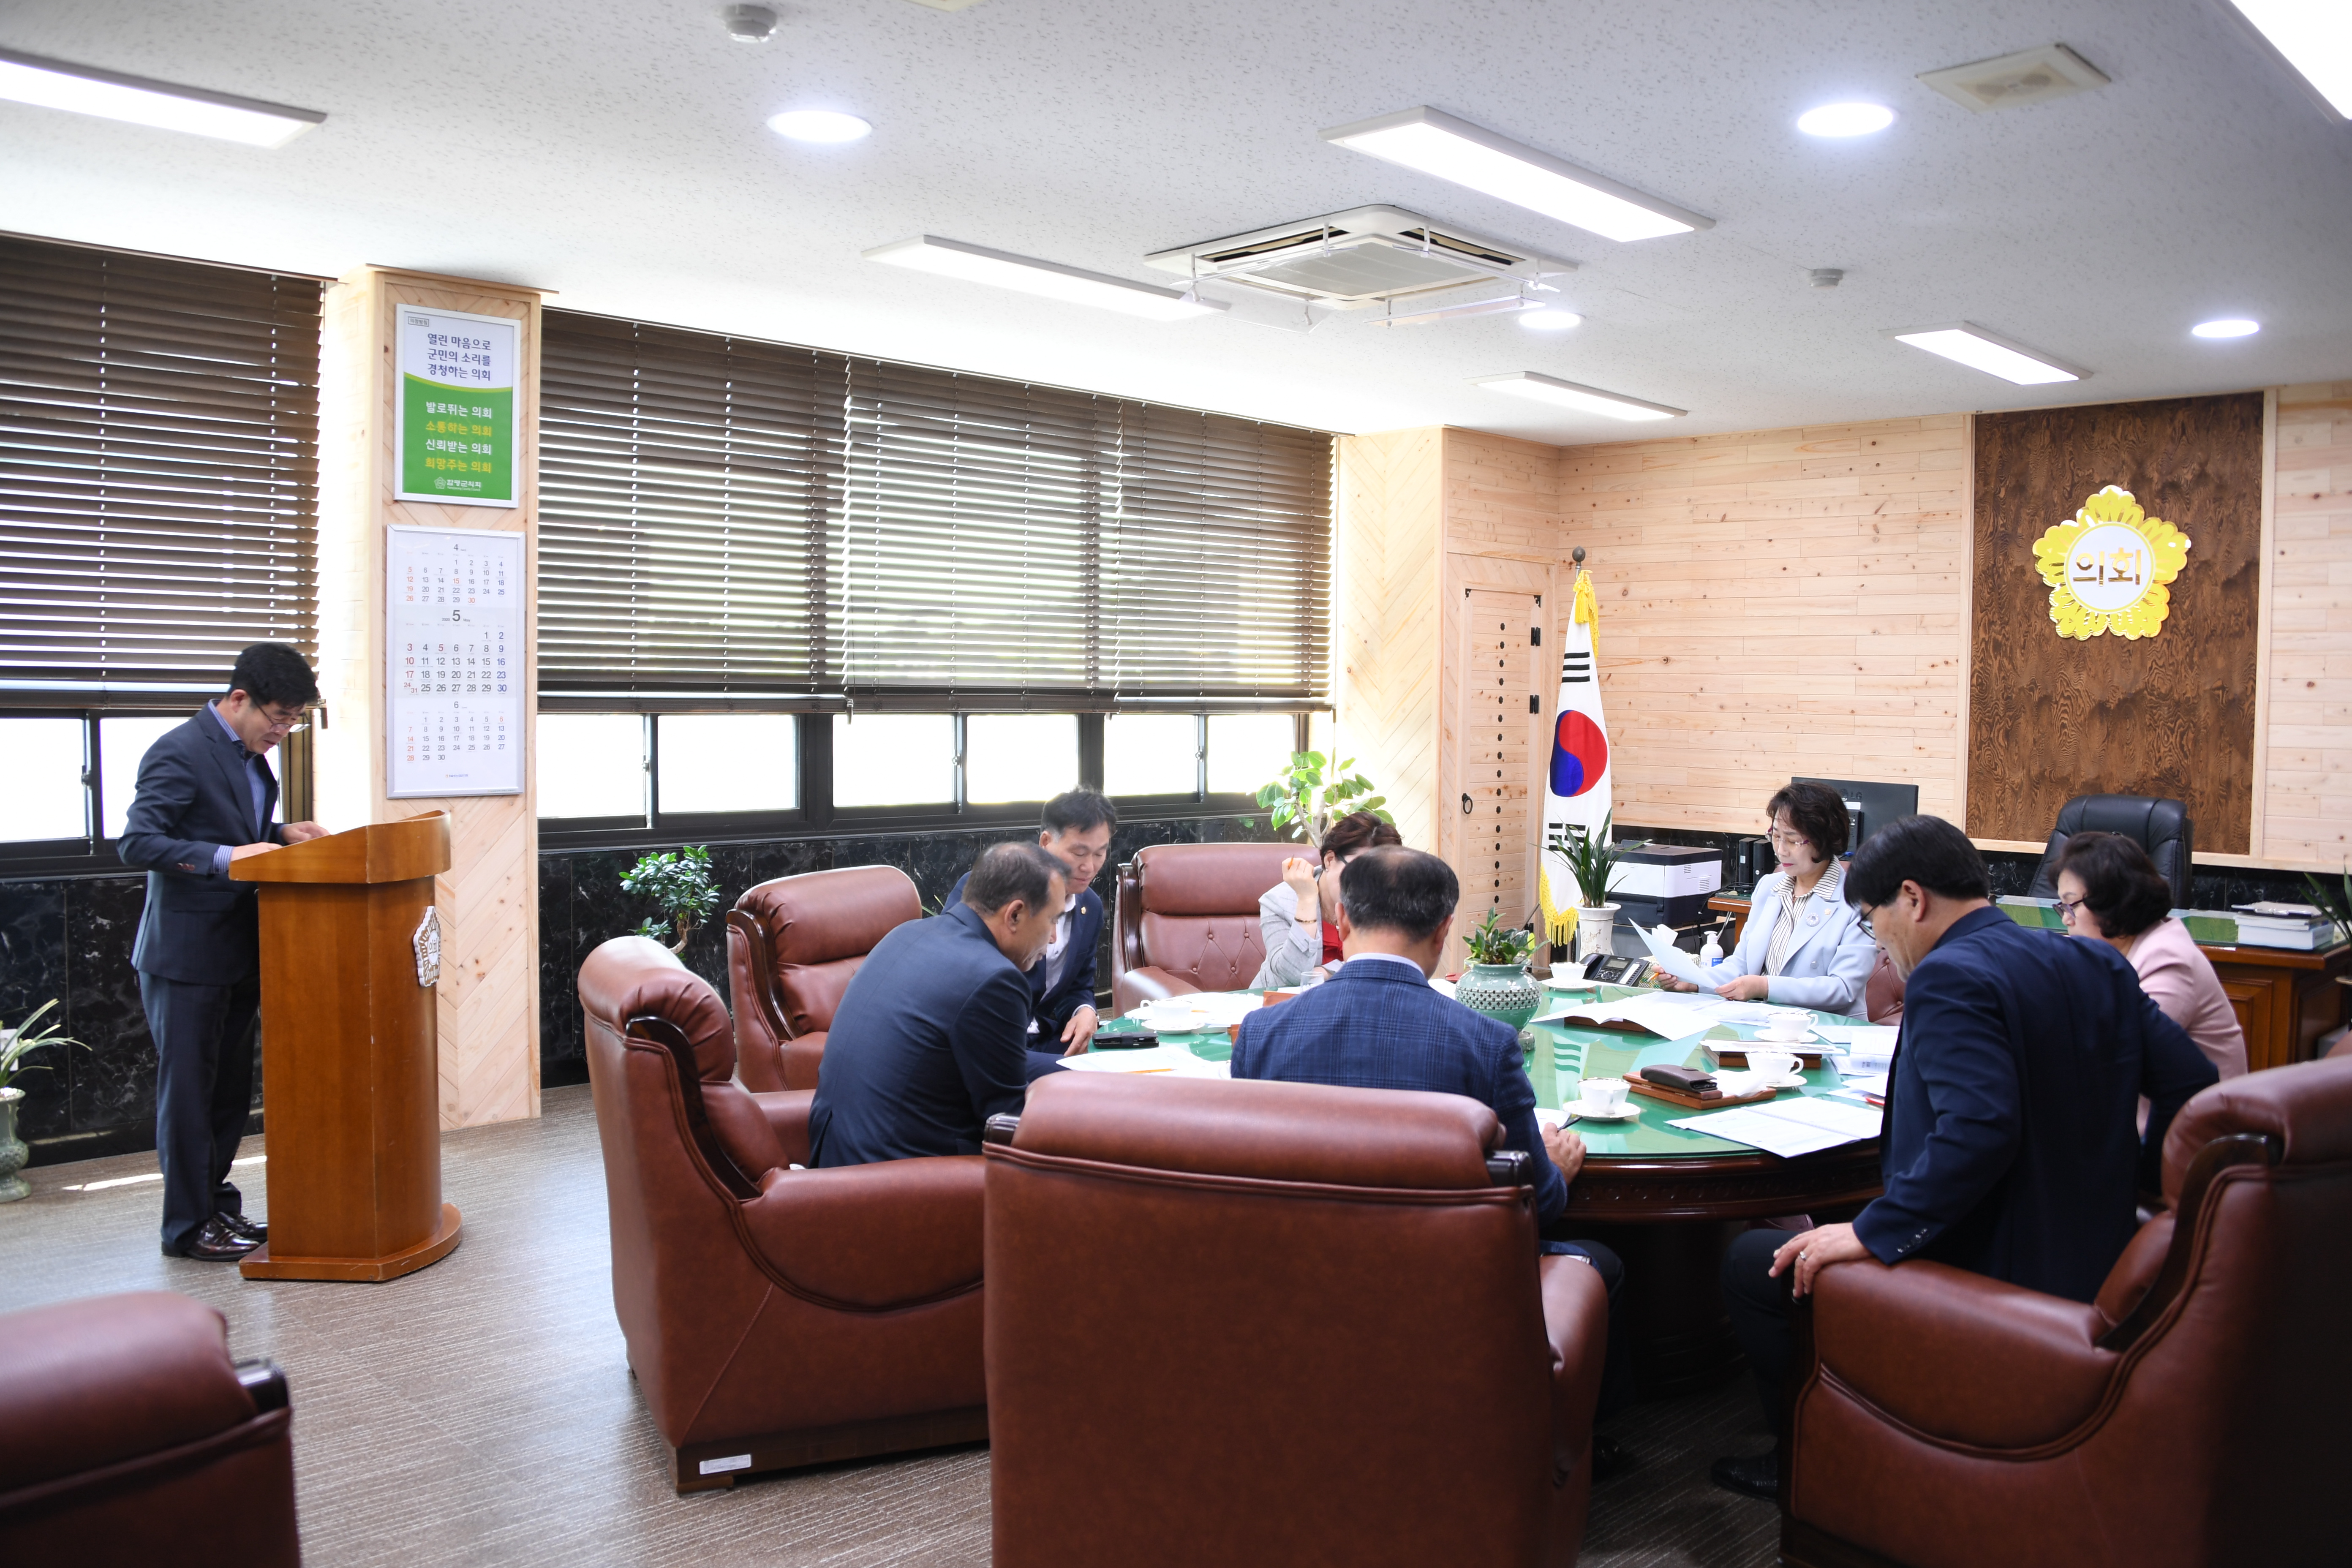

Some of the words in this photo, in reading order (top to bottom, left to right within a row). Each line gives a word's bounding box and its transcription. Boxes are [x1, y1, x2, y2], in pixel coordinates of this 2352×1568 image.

[427, 333, 447, 345] 열린
[451, 336, 491, 351] 마음으로
[427, 348, 457, 362] 군민의
[461, 352, 491, 366] 소리를
[427, 364, 468, 378] 경청하는
[471, 369, 490, 381] 의회
[426, 402, 468, 417] 발로뛰는
[472, 407, 492, 419] 의회
[426, 421, 467, 435] 소통하는
[472, 425, 491, 437] 의회
[426, 439, 467, 454] 신뢰받는
[471, 443, 491, 455] 의회
[425, 457, 467, 472] 희망주는
[471, 461, 491, 473] 의회
[2073, 547, 2141, 587] 의회
[452, 610, 460, 621] 5
